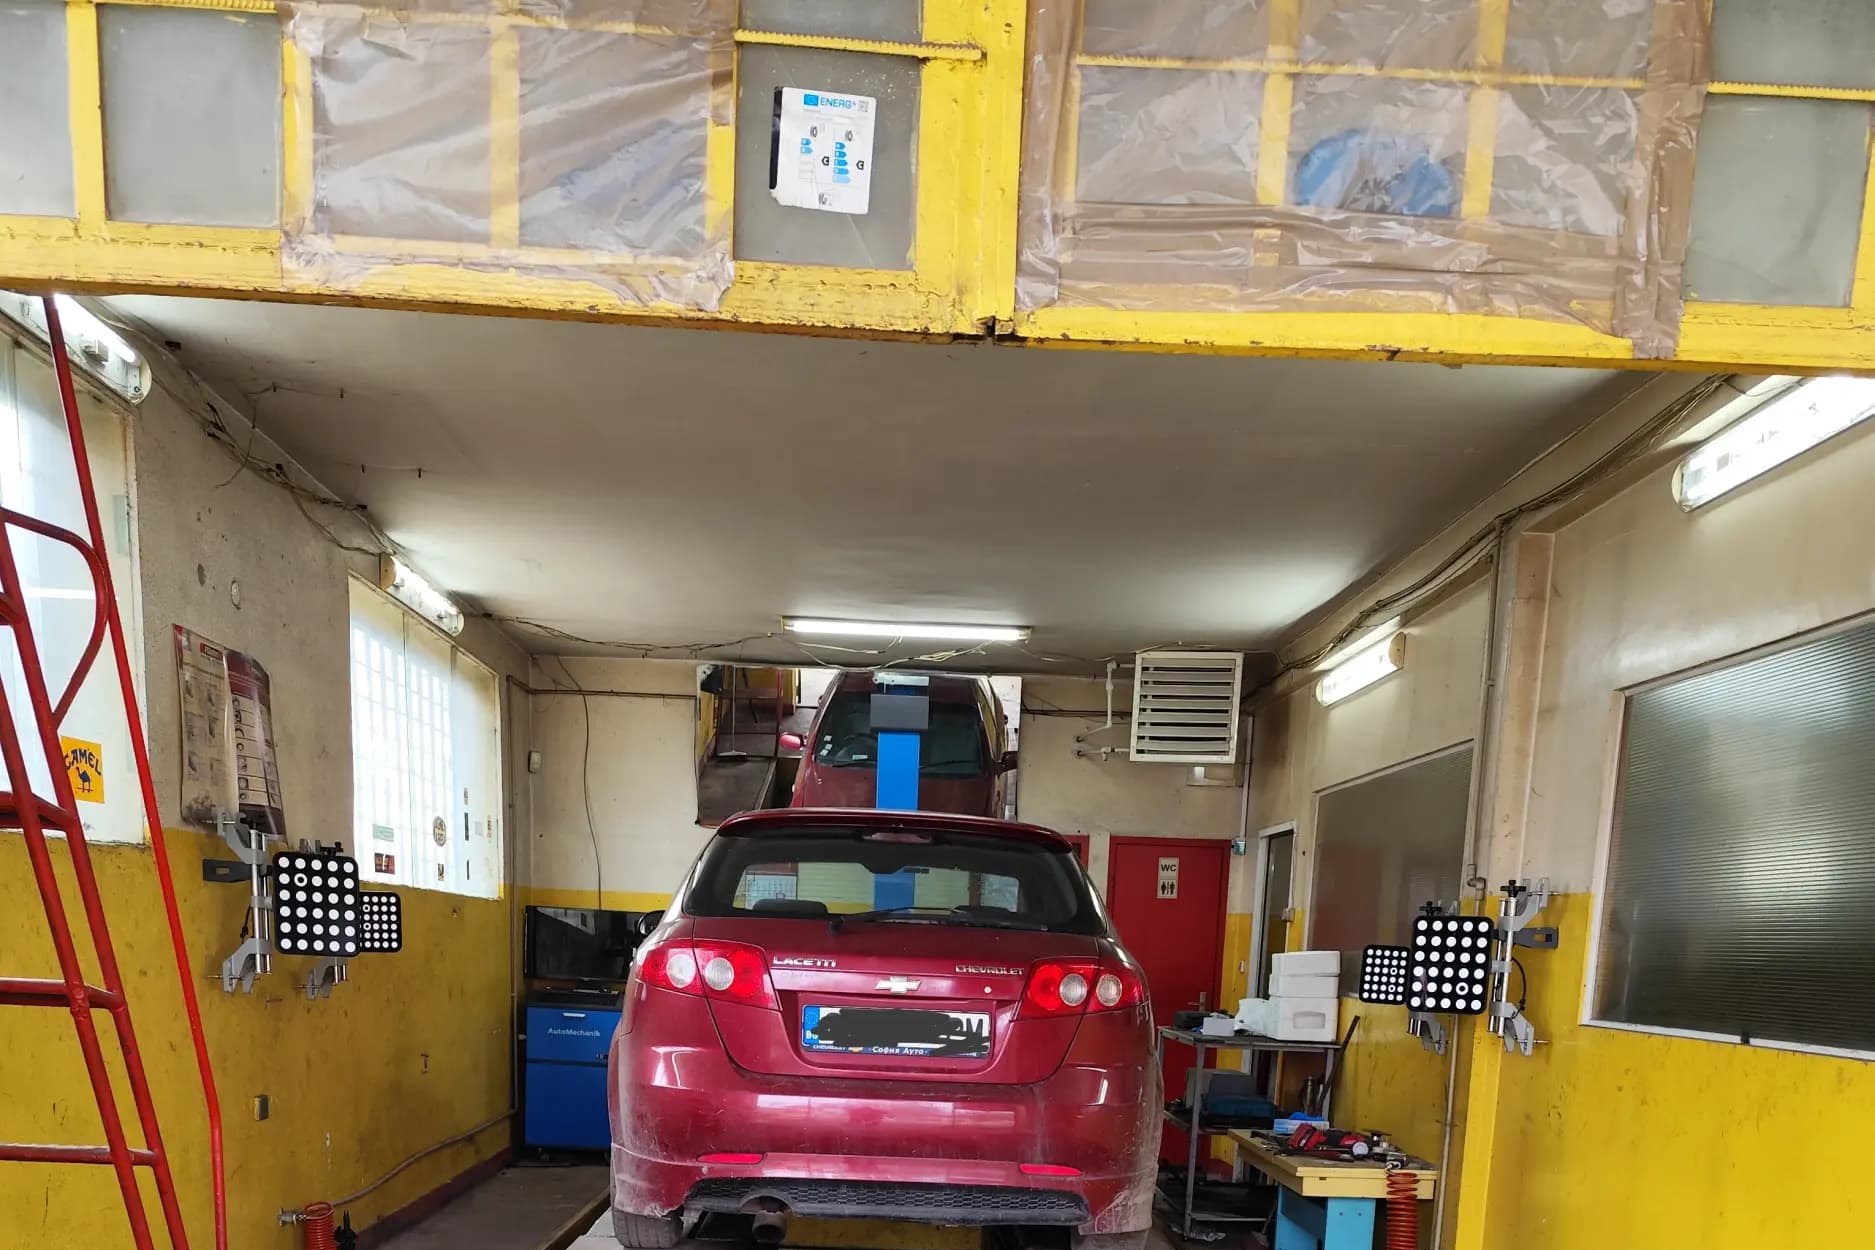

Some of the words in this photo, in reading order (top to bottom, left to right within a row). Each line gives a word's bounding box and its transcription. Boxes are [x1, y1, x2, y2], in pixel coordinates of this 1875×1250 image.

[63, 748, 102, 776] CAMEL
[1160, 863, 1177, 872] WC
[772, 956, 837, 968] LACETTI
[955, 964, 1025, 976] CHEVROLET
